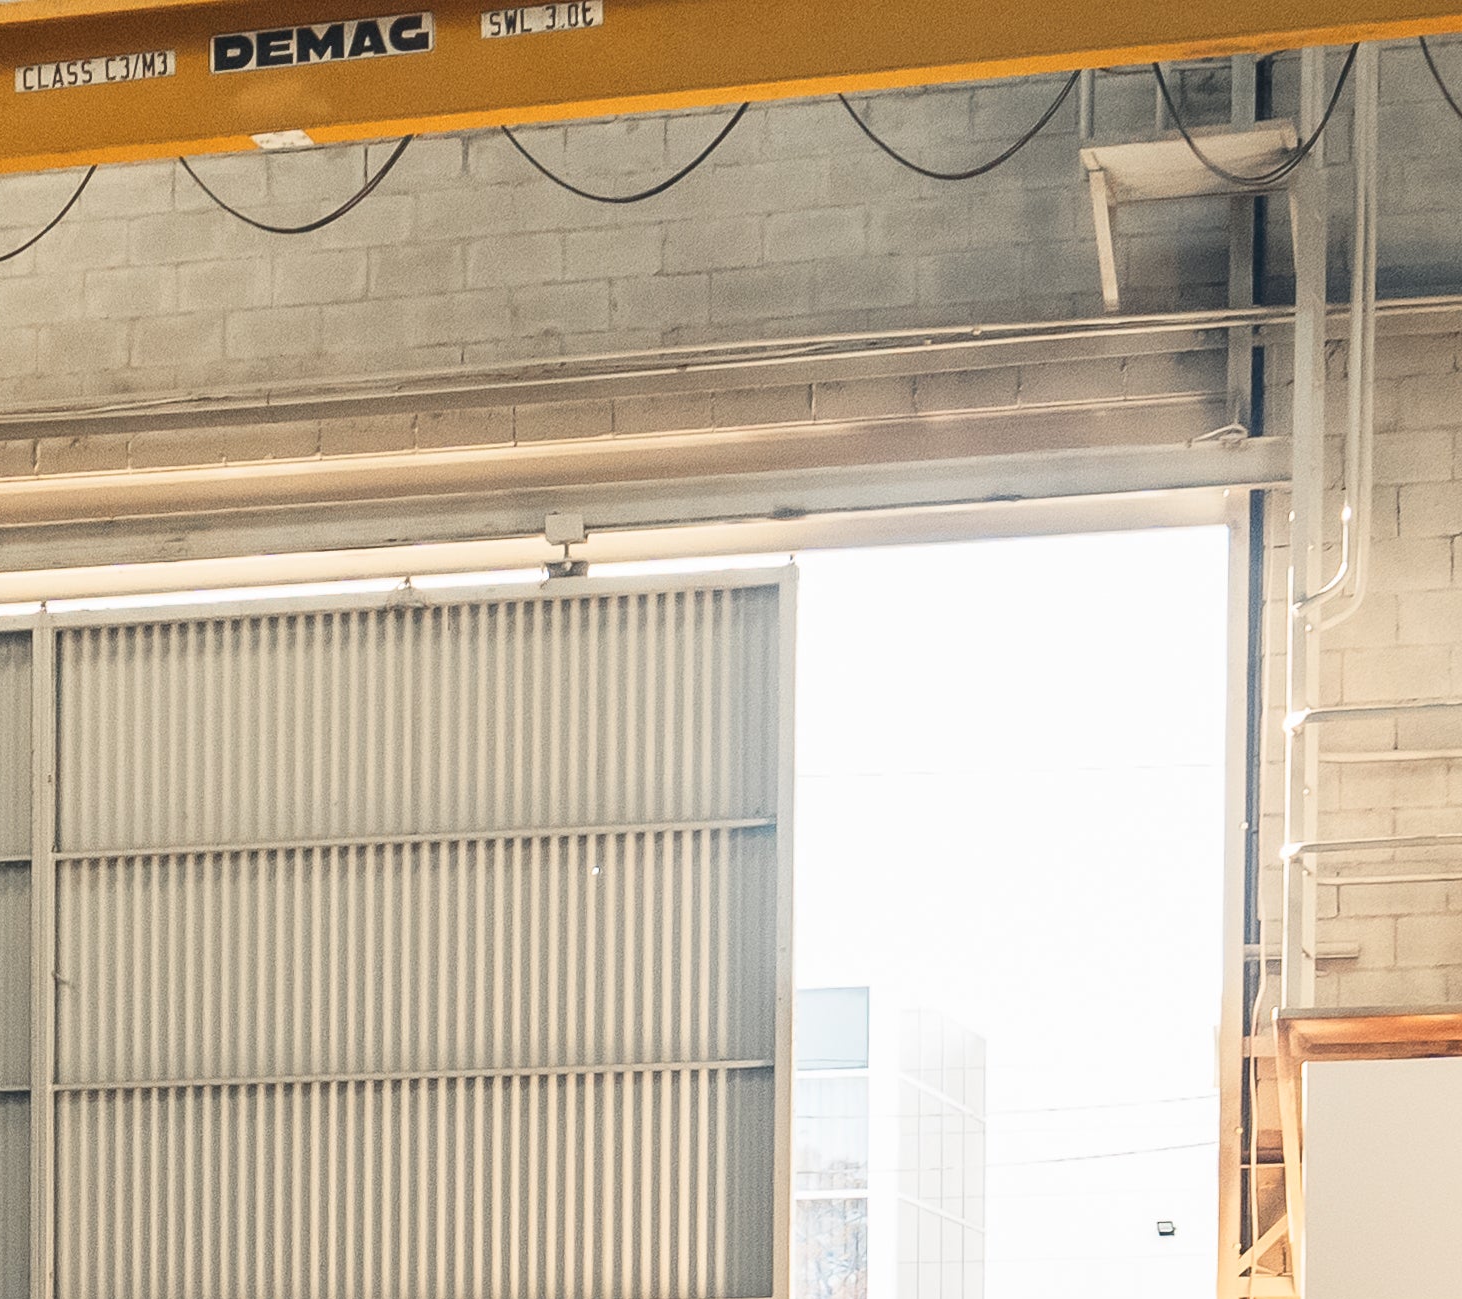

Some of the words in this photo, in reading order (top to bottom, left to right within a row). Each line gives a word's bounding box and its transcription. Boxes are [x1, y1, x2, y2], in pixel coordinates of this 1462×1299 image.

[489, 10, 532, 36] SWL
[545, 1, 594, 31] 3.0t
[214, 15, 430, 73] DEMAG
[22, 61, 93, 91] CLASS
[105, 51, 168, 82] C3/M3
